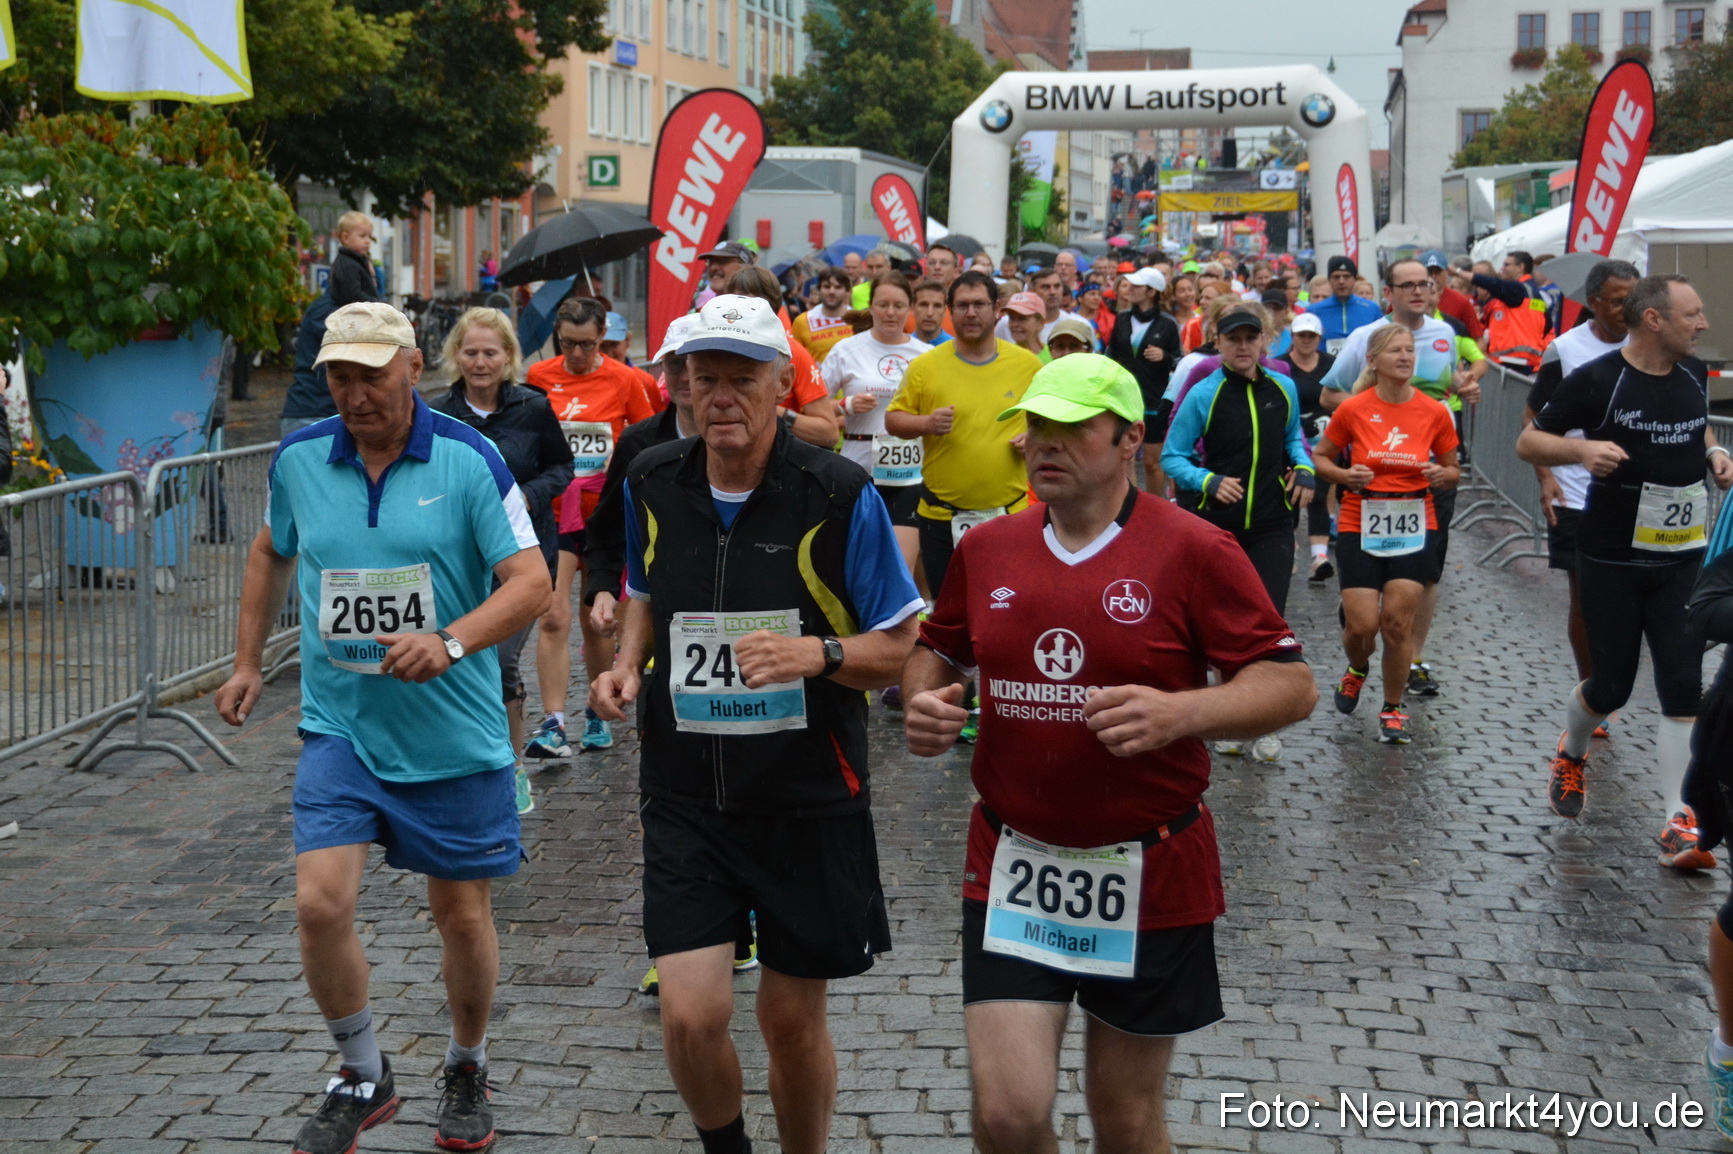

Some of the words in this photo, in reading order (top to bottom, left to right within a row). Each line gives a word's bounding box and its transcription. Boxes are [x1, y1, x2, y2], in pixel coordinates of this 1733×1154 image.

[1025, 84, 1115, 111] BMW
[1125, 81, 1287, 113] Laufsport
[592, 159, 615, 183] D
[1574, 89, 1644, 253] REWE
[655, 112, 746, 283] REWE
[1213, 196, 1243, 208] ZIEL
[1339, 174, 1355, 257] REWE
[811, 331, 833, 342] MAX
[1614, 408, 1642, 426] Vegan
[1628, 419, 1671, 433] Laufen
[1674, 416, 1706, 434] gegen
[567, 433, 607, 454] 625
[1651, 432, 1690, 444] Leiden
[878, 445, 921, 465] 2593
[1366, 449, 1417, 460] funrunners
[576, 460, 595, 469] rista
[886, 469, 913, 479] Ricarda
[1663, 502, 1693, 527] 28
[1369, 513, 1419, 535] 2143
[1381, 540, 1406, 549] Conny
[1654, 531, 1691, 543] Michael
[366, 569, 421, 586] BOCK
[1122, 584, 1133, 596] 1.
[332, 591, 426, 634] 2654
[1108, 596, 1145, 614] FCN
[681, 626, 717, 635] NeuerMarkt
[724, 616, 788, 631] BOCK
[344, 645, 388, 662] Wolfg
[684, 643, 748, 687] 24
[709, 699, 768, 717] Hubert
[994, 702, 1090, 722] VERSICHER
[1006, 859, 1126, 922] 2636
[1023, 921, 1097, 953] Michael
